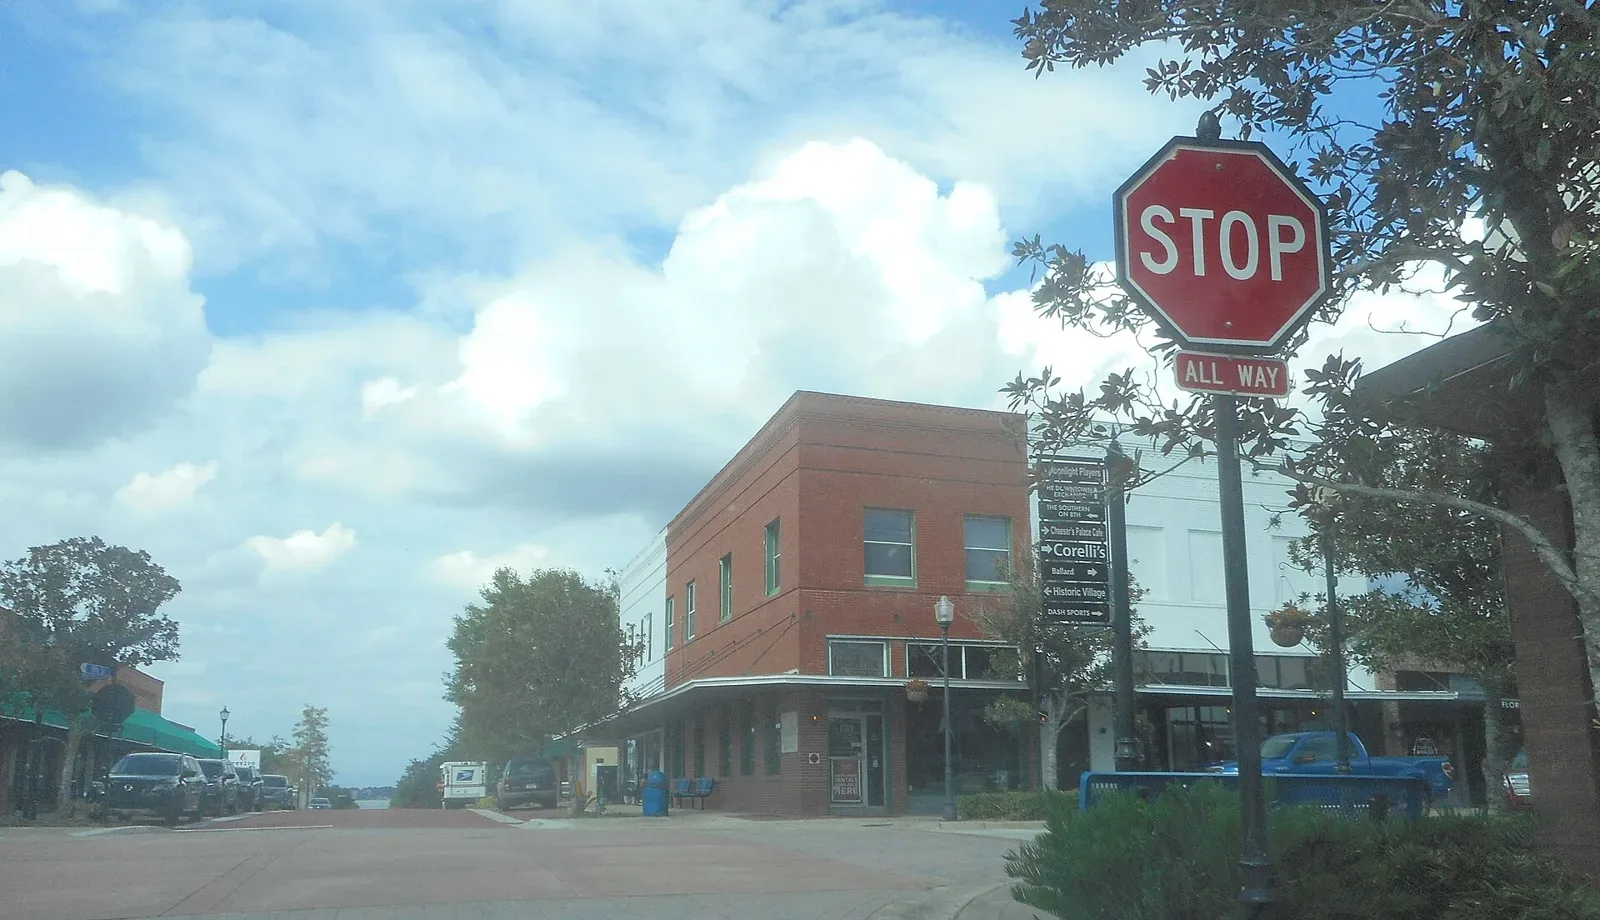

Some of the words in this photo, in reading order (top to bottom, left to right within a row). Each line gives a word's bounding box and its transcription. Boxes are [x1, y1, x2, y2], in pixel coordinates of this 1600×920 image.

[1140, 205, 1306, 281] STOP
[1185, 360, 1224, 385] ALL
[1238, 364, 1279, 389] WAY
[1079, 467, 1102, 479] Players
[1058, 504, 1090, 512] SOUTHERN
[1075, 527, 1092, 537] Palace
[1053, 543, 1106, 559] Corelli's
[1051, 567, 1075, 576] Ballard
[1053, 586, 1081, 597] Historic
[1082, 587, 1106, 599] Village
[1048, 608, 1066, 616] DASH
[1066, 609, 1091, 617] SPORTS
[834, 787, 858, 795] HERE
